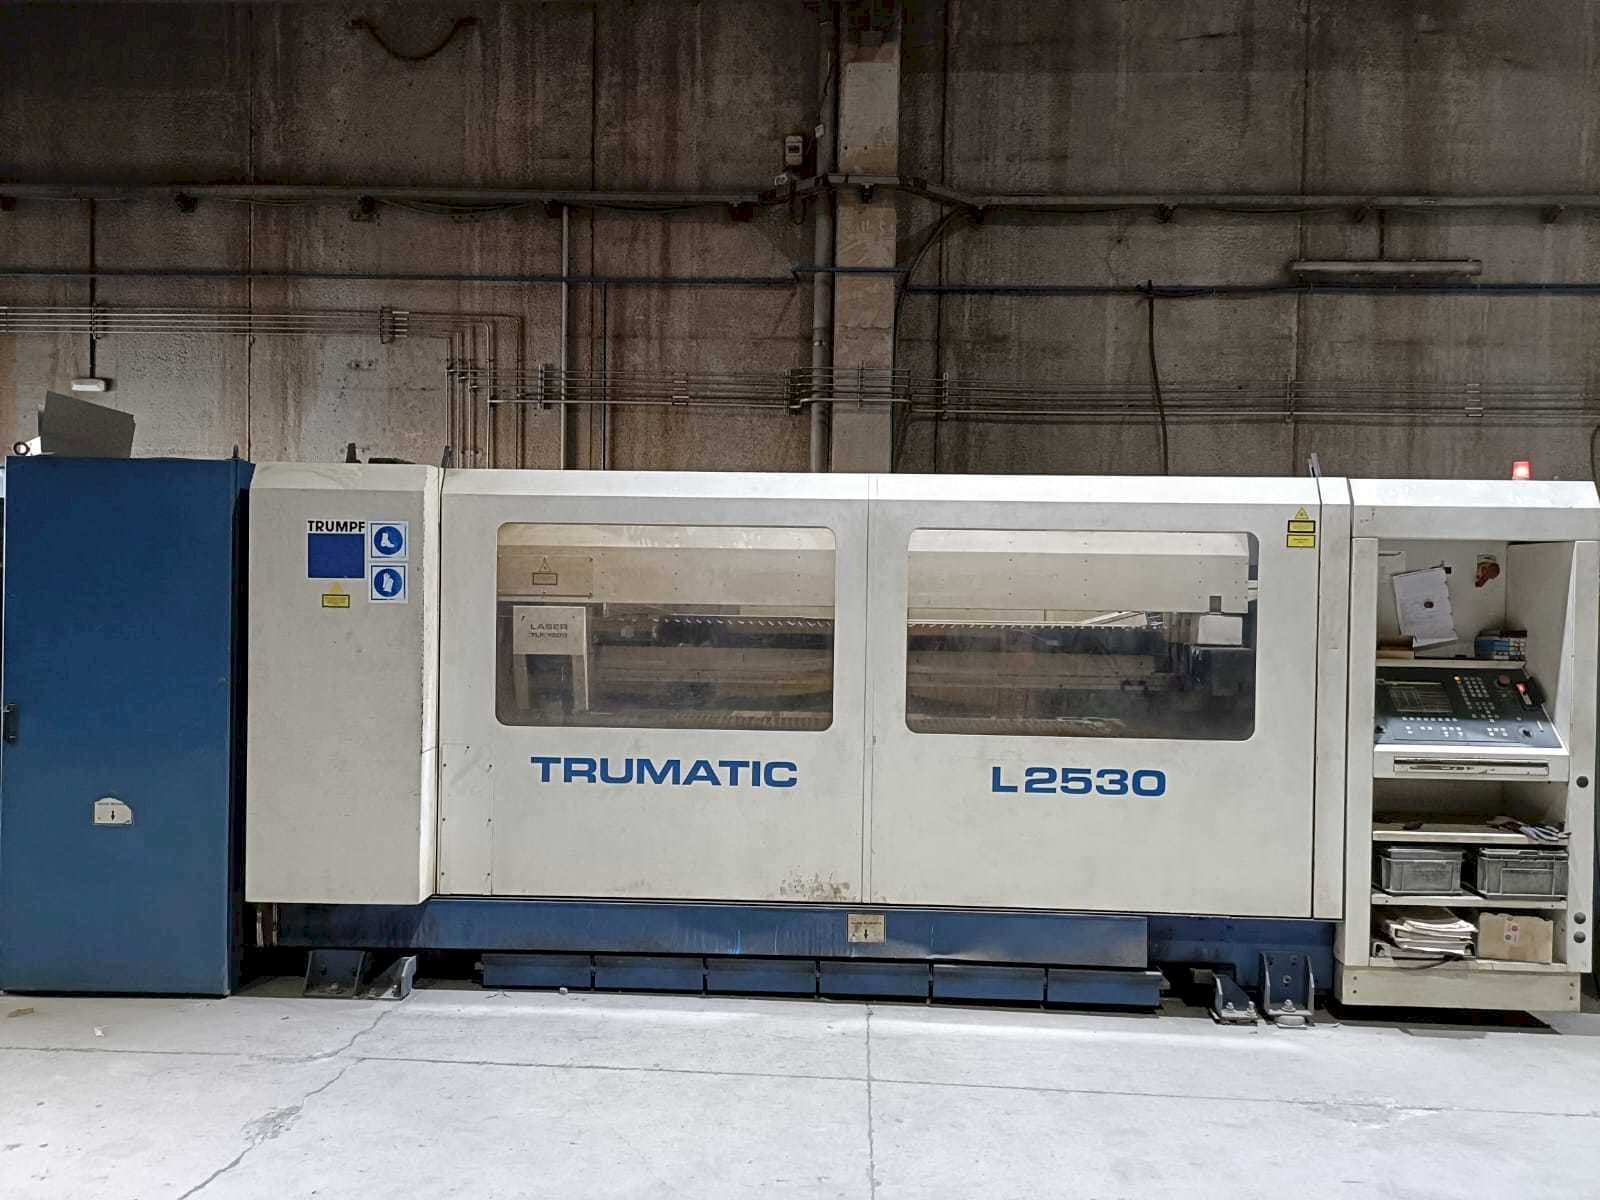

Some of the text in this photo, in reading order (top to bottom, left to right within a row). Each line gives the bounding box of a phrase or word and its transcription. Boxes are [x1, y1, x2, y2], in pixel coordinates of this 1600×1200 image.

[307, 520, 366, 533] TRUMPF
[530, 756, 798, 788] TRUMATIC
[992, 766, 1166, 797] L2530
